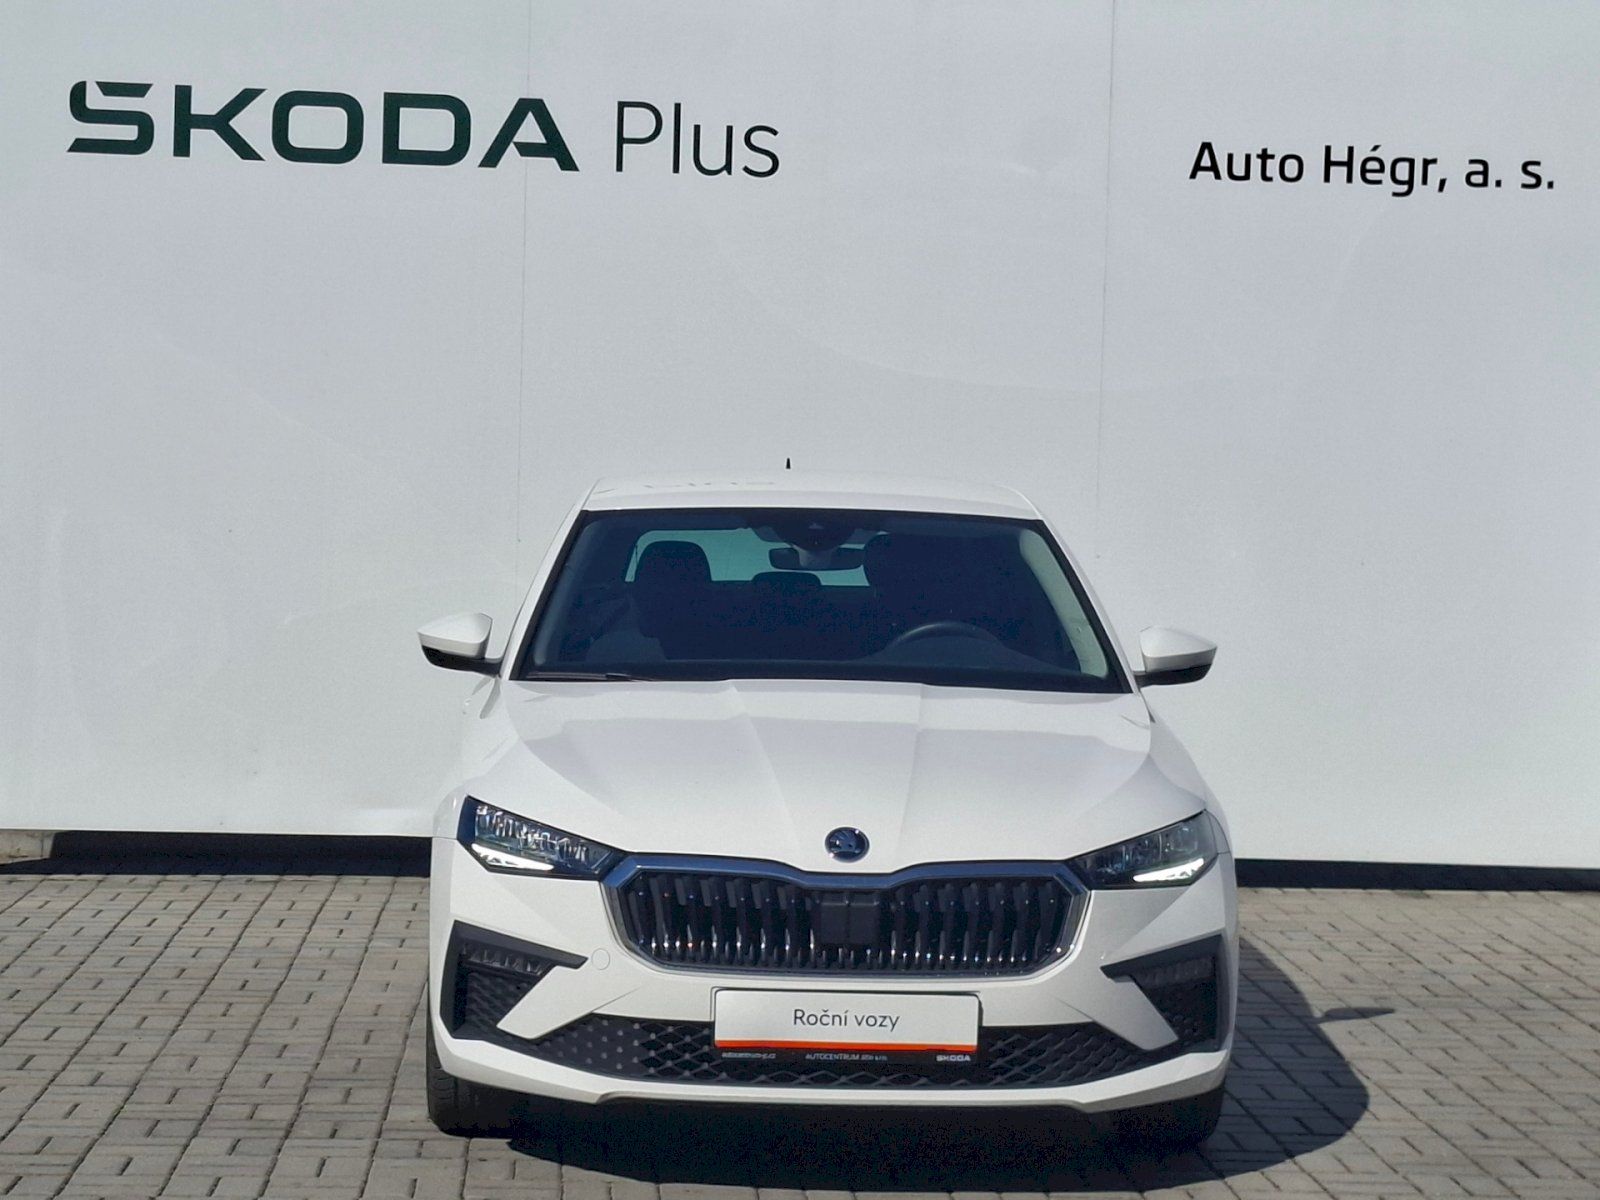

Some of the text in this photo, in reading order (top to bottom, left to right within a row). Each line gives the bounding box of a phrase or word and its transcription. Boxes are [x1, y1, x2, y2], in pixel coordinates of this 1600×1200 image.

[615, 100, 780, 179] Plus
[1189, 141, 1555, 198] Auto Hégr, a. s.
[793, 1008, 901, 1033] Roční vozy
